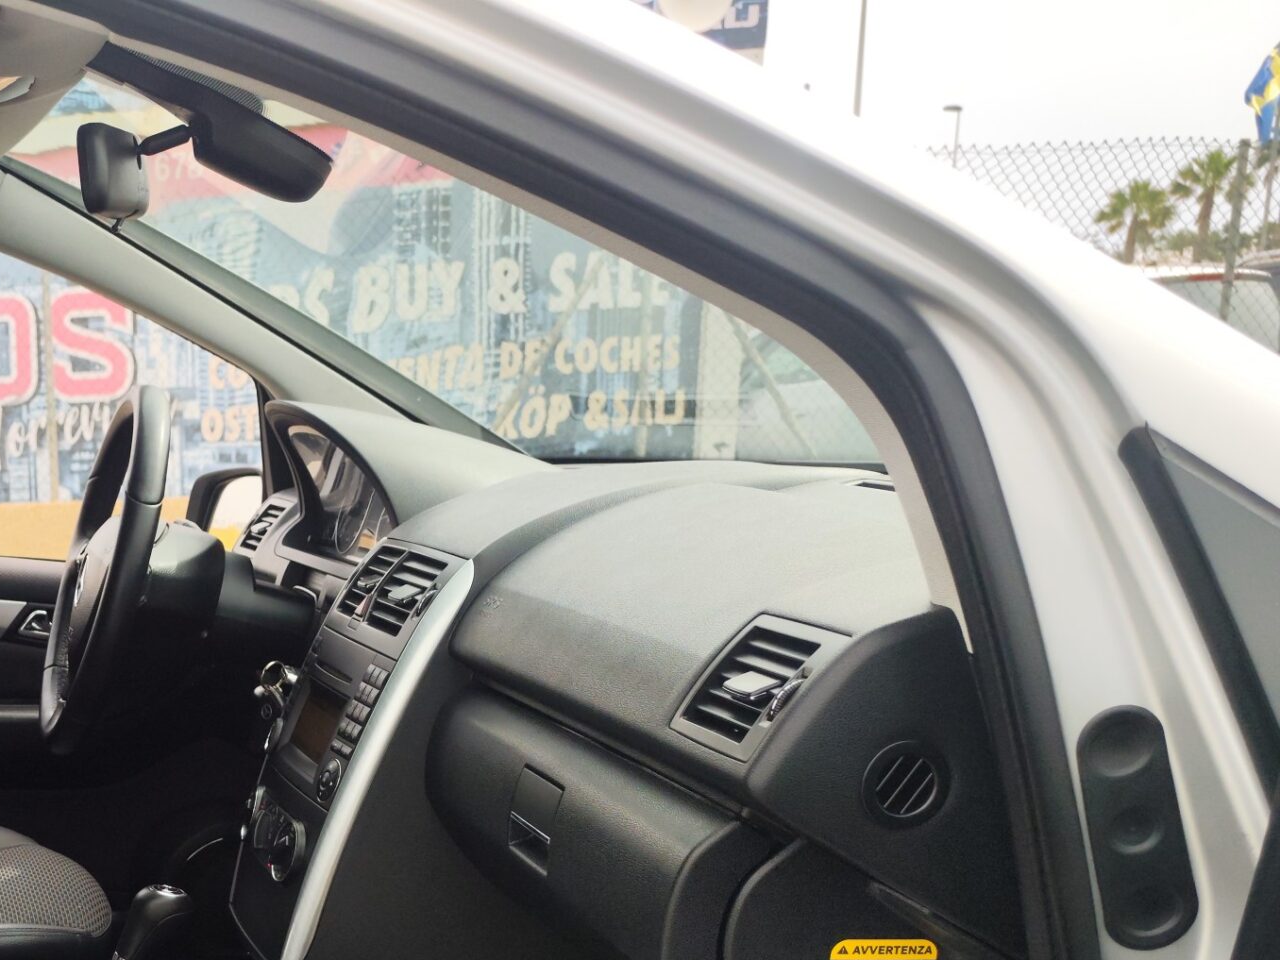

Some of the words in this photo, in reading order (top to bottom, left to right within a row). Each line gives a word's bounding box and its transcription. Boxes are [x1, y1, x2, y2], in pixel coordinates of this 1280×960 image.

[351, 260, 465, 334] BUY
[487, 257, 527, 314] &
[554, 335, 681, 375] COCHES
[852, 945, 933, 955] AVVERTENZA
